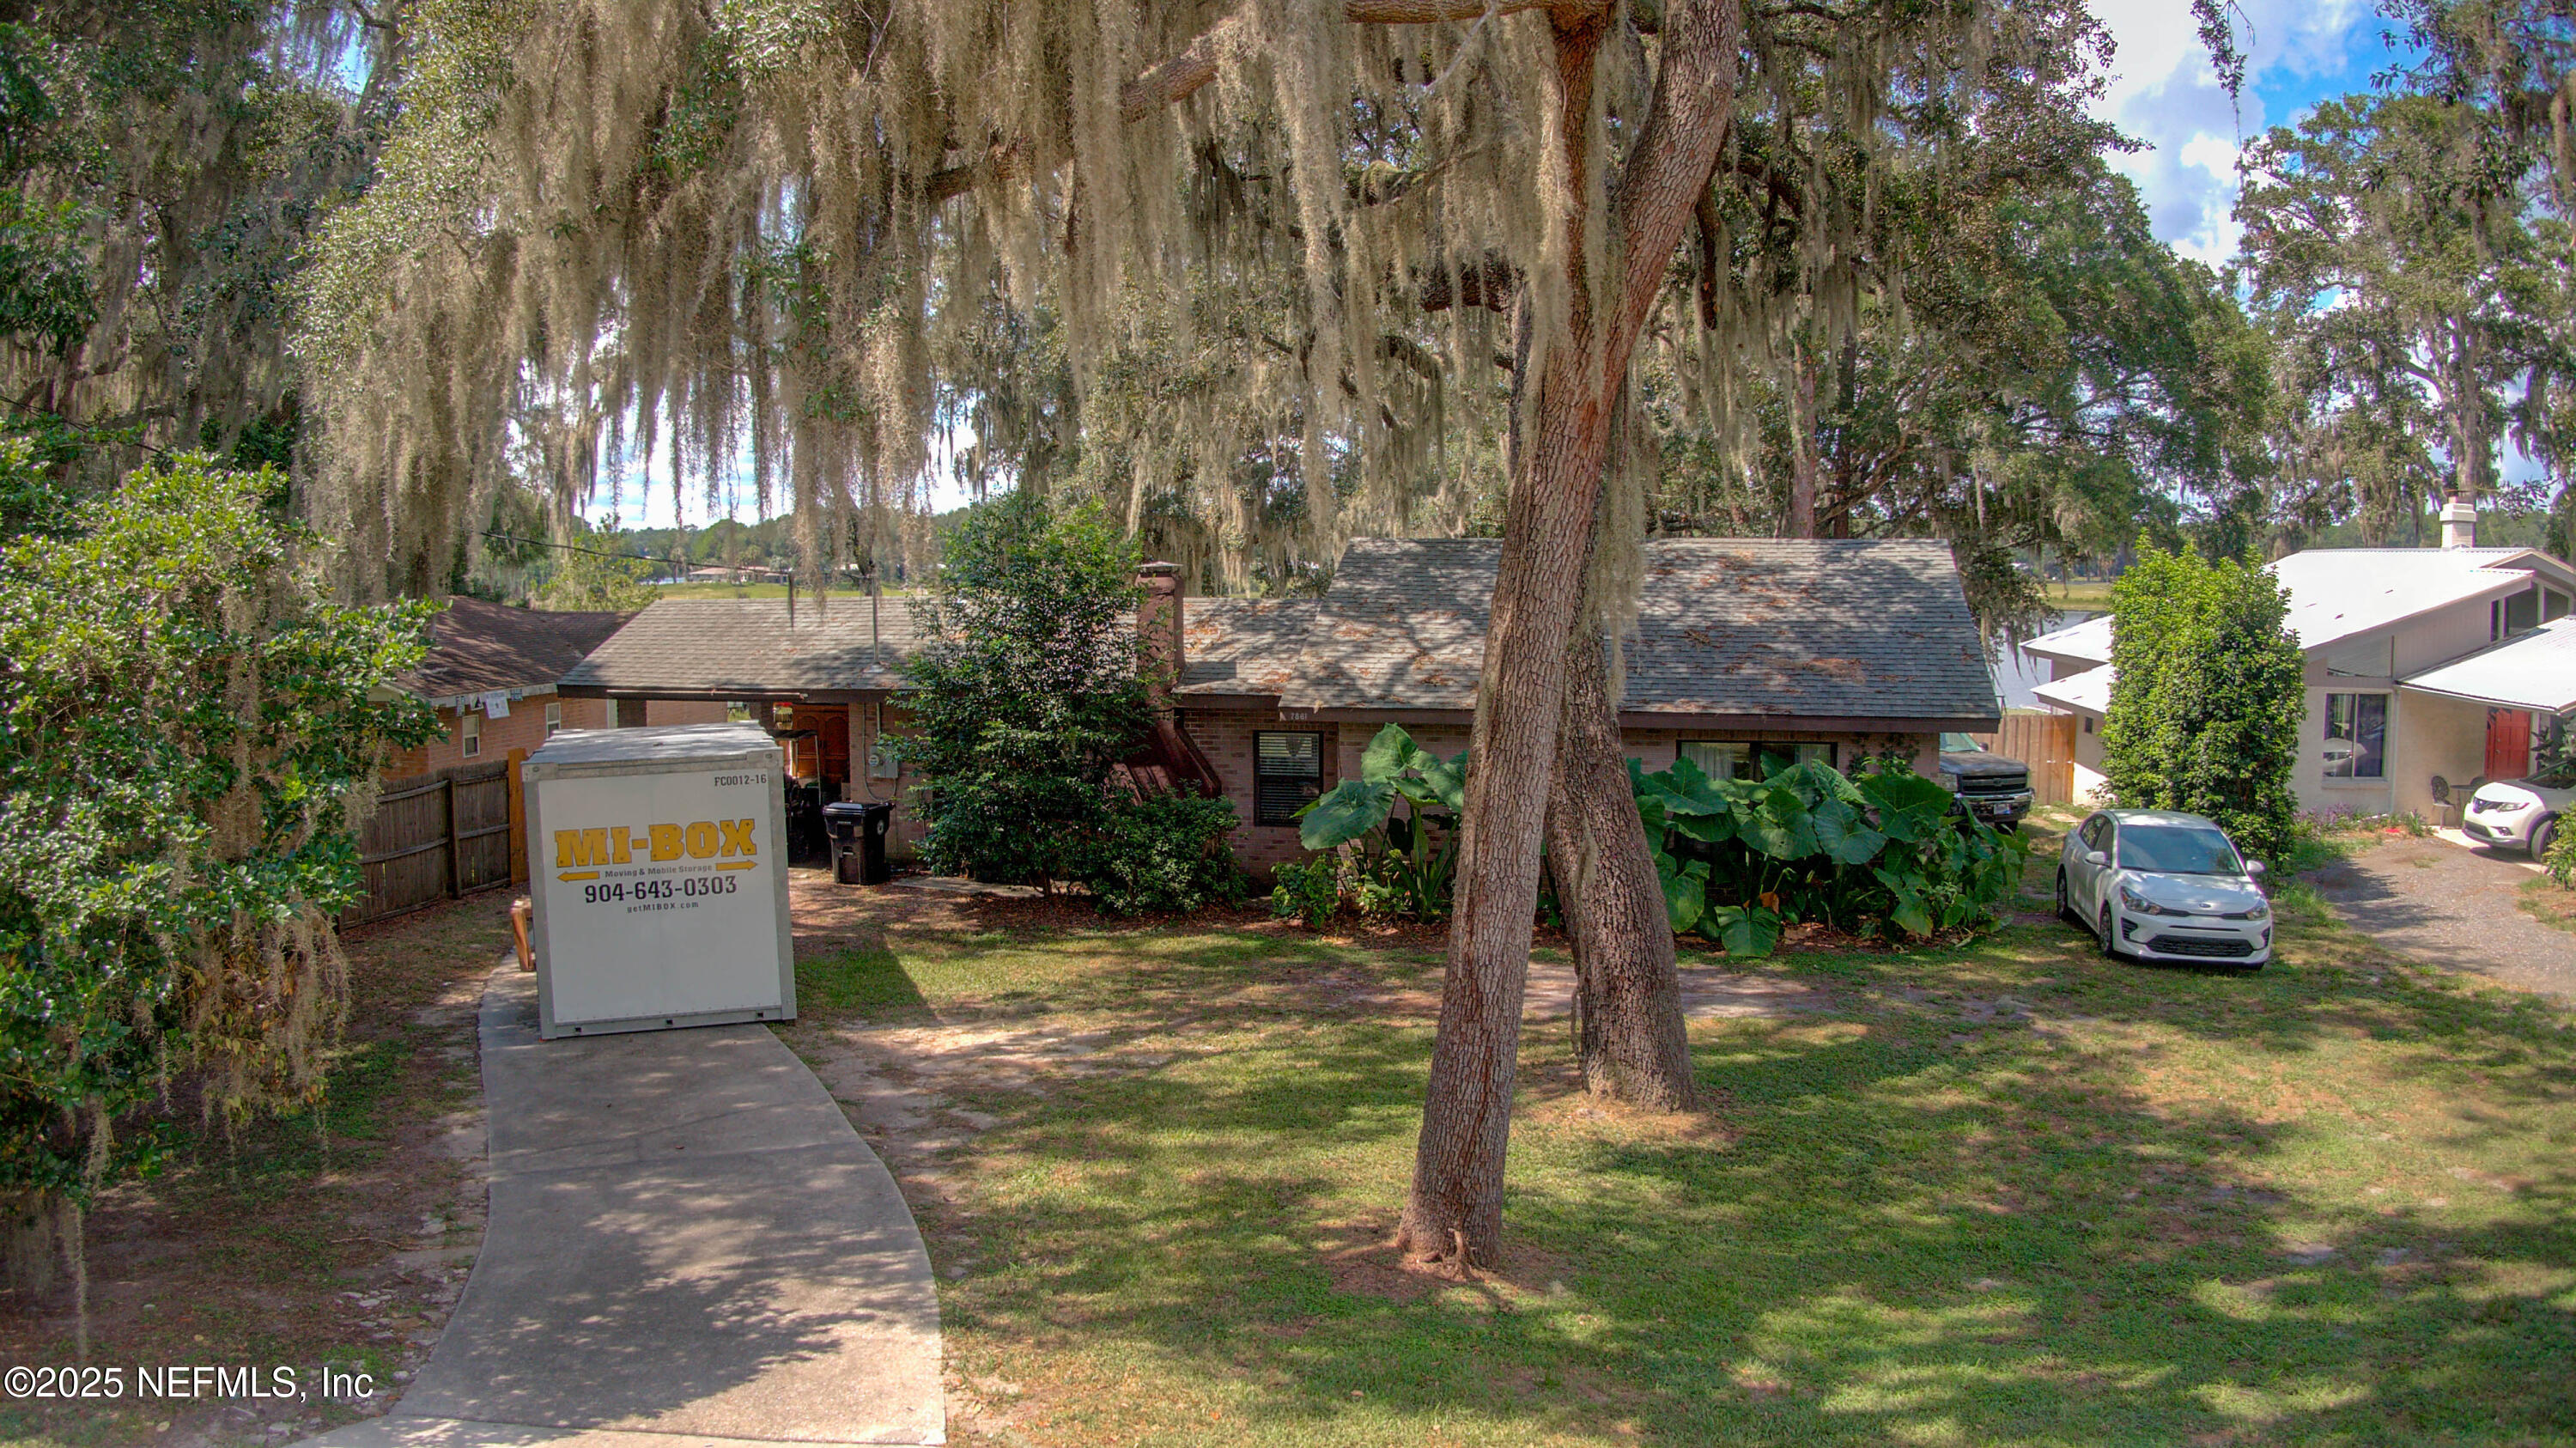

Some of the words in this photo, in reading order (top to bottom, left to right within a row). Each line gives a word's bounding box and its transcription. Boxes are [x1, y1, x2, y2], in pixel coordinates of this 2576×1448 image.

[714, 774, 767, 787] FC0012-16
[554, 818, 757, 868] MI-BOX
[605, 868, 638, 879] Moving
[639, 867, 646, 876] &
[647, 866, 677, 875] Mobile
[678, 864, 713, 873] Storage
[585, 875, 737, 903] 904-643-0303
[627, 901, 699, 913] getMIBOX.com
